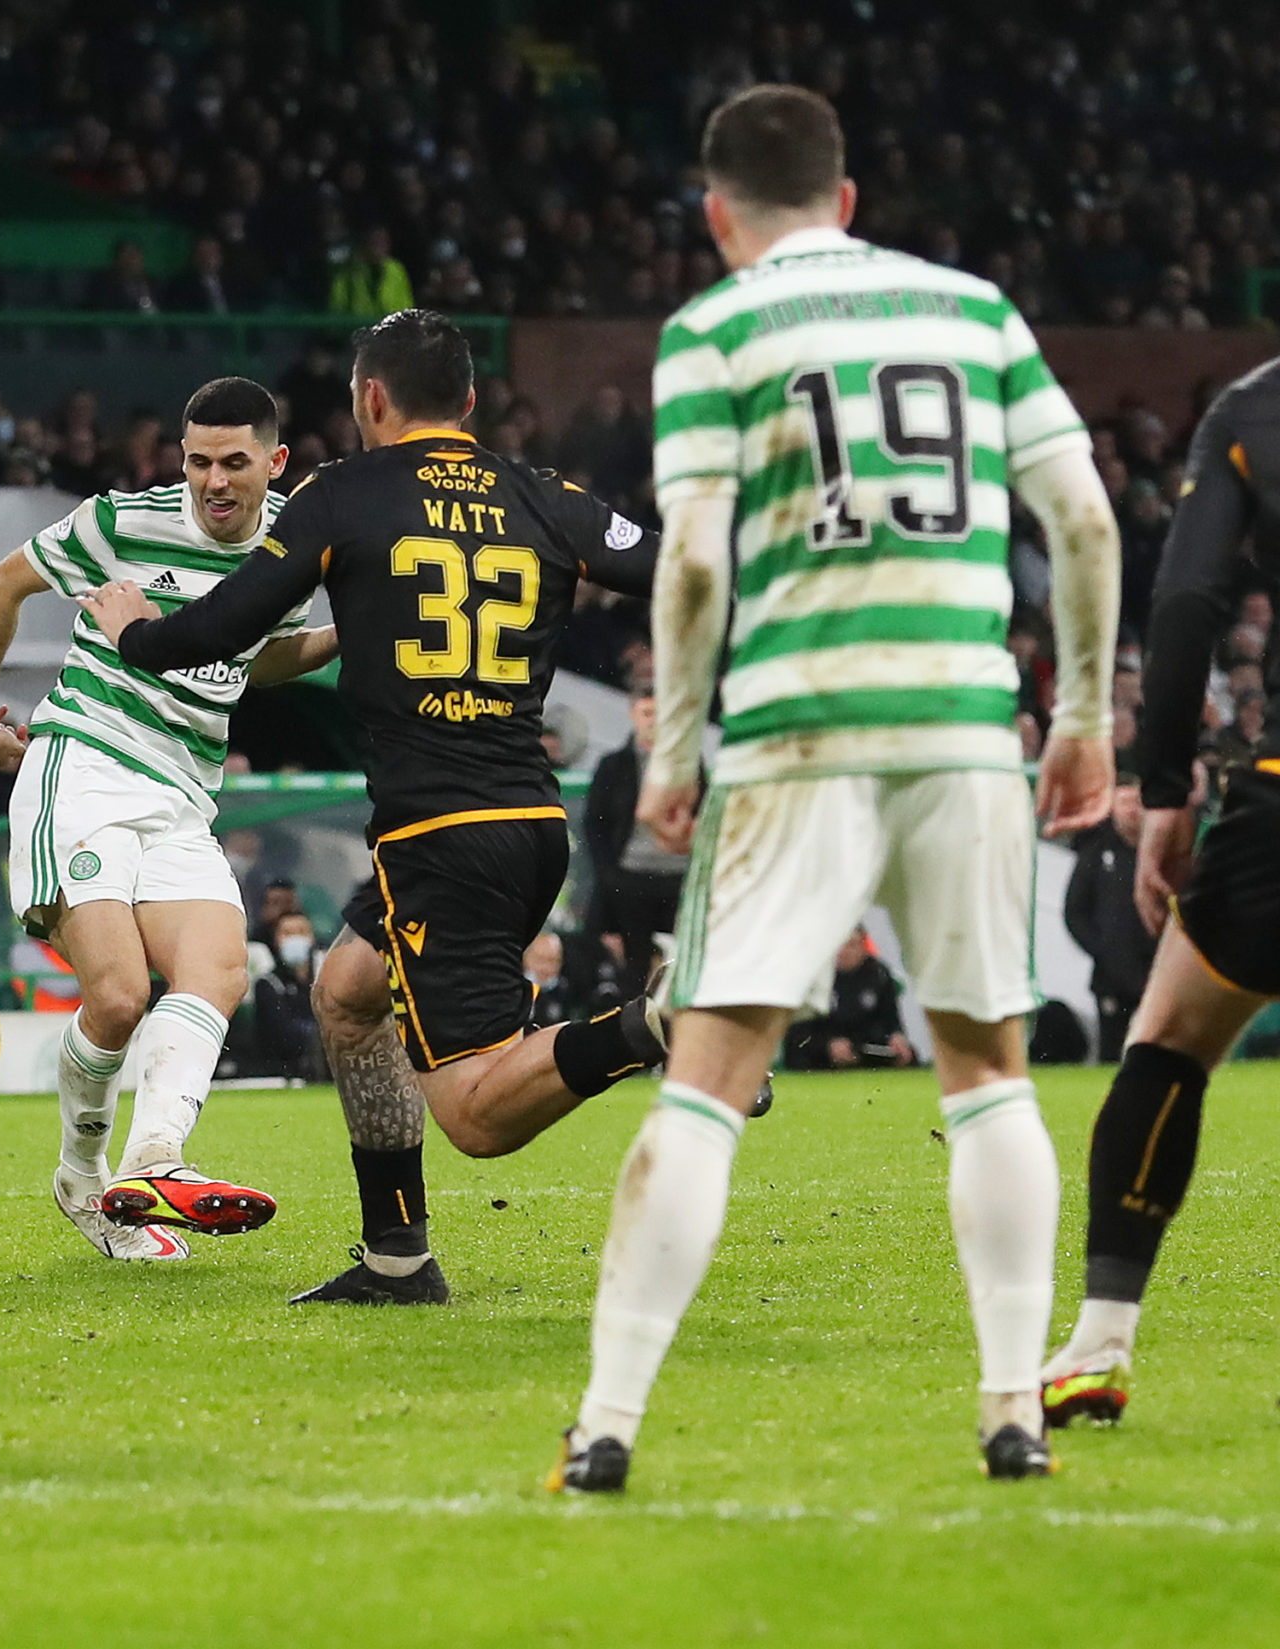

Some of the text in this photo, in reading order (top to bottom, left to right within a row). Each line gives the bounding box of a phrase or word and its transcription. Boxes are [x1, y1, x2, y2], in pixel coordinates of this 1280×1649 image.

[749, 289, 962, 337] JOHNSTON
[416, 462, 497, 487] GLEN'S
[785, 360, 973, 552] 19
[430, 478, 488, 494] VODKA
[423, 498, 506, 535] WATT
[149, 582, 180, 592] adidas
[390, 535, 541, 685] 32
